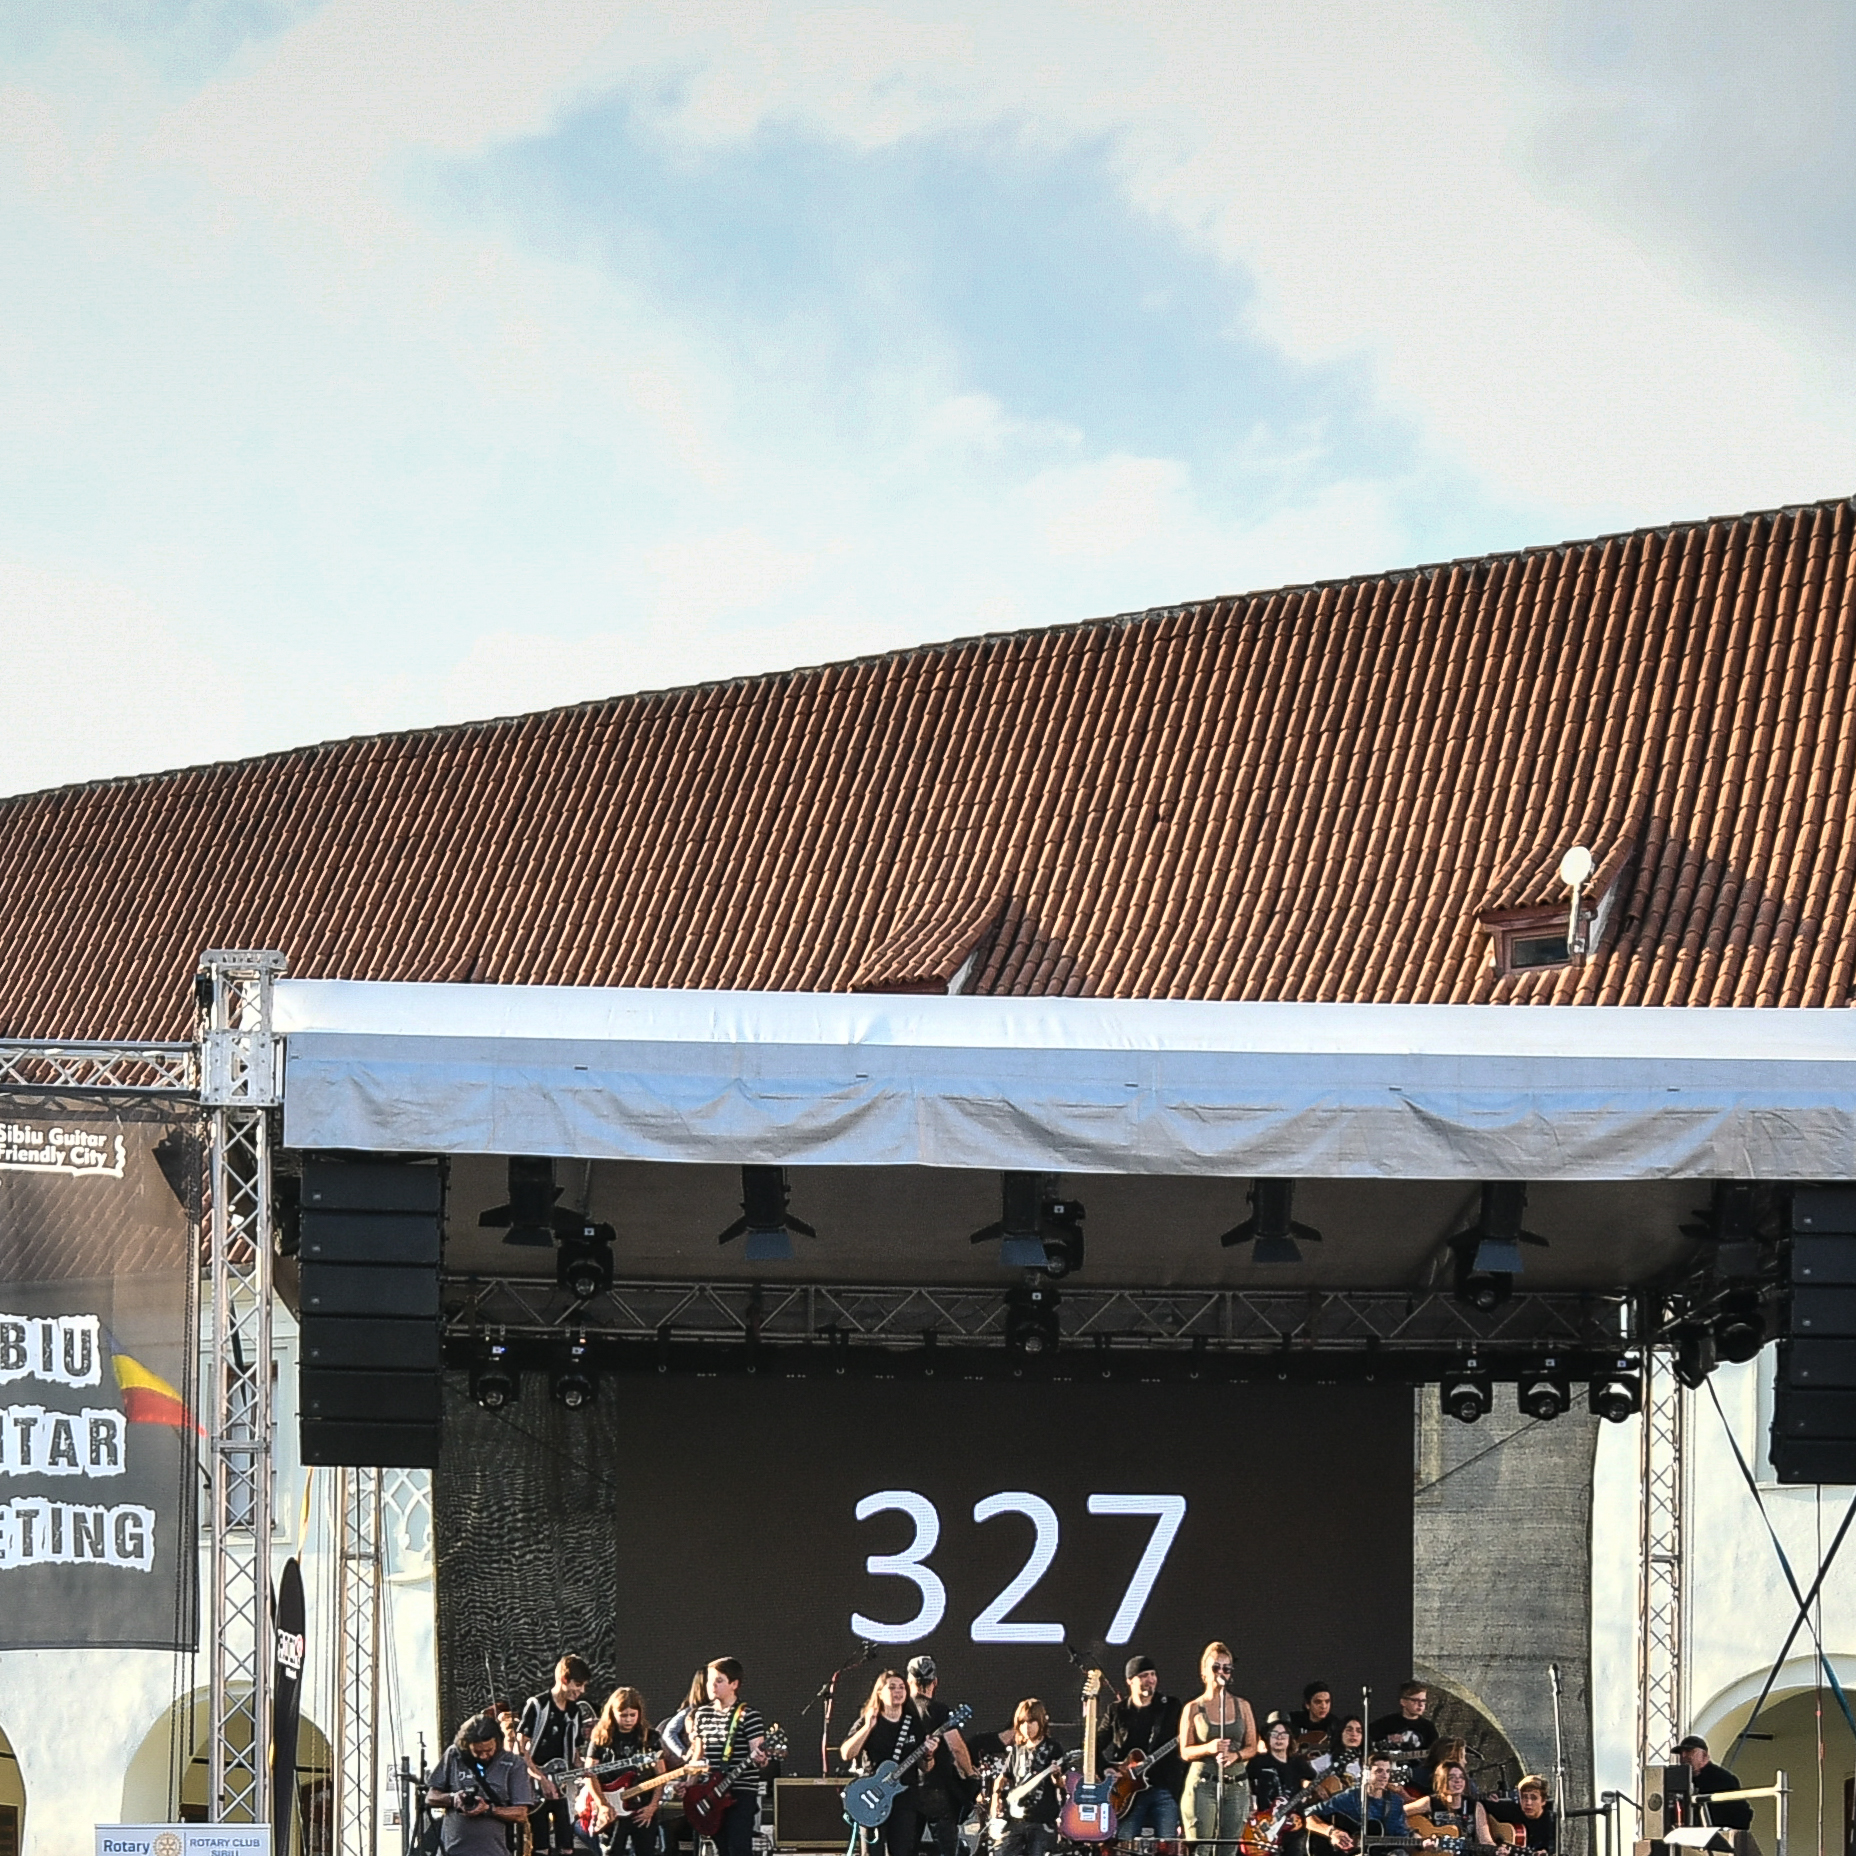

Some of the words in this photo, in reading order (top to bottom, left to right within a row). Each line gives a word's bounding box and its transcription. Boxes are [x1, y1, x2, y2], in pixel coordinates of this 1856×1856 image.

[49, 1126, 108, 1149] Guitar
[69, 1147, 109, 1169] City
[851, 1490, 1187, 1645] 327
[103, 1839, 151, 1855] Rotary
[189, 1838, 228, 1848] ROTARY
[232, 1838, 261, 1848] CLUB
